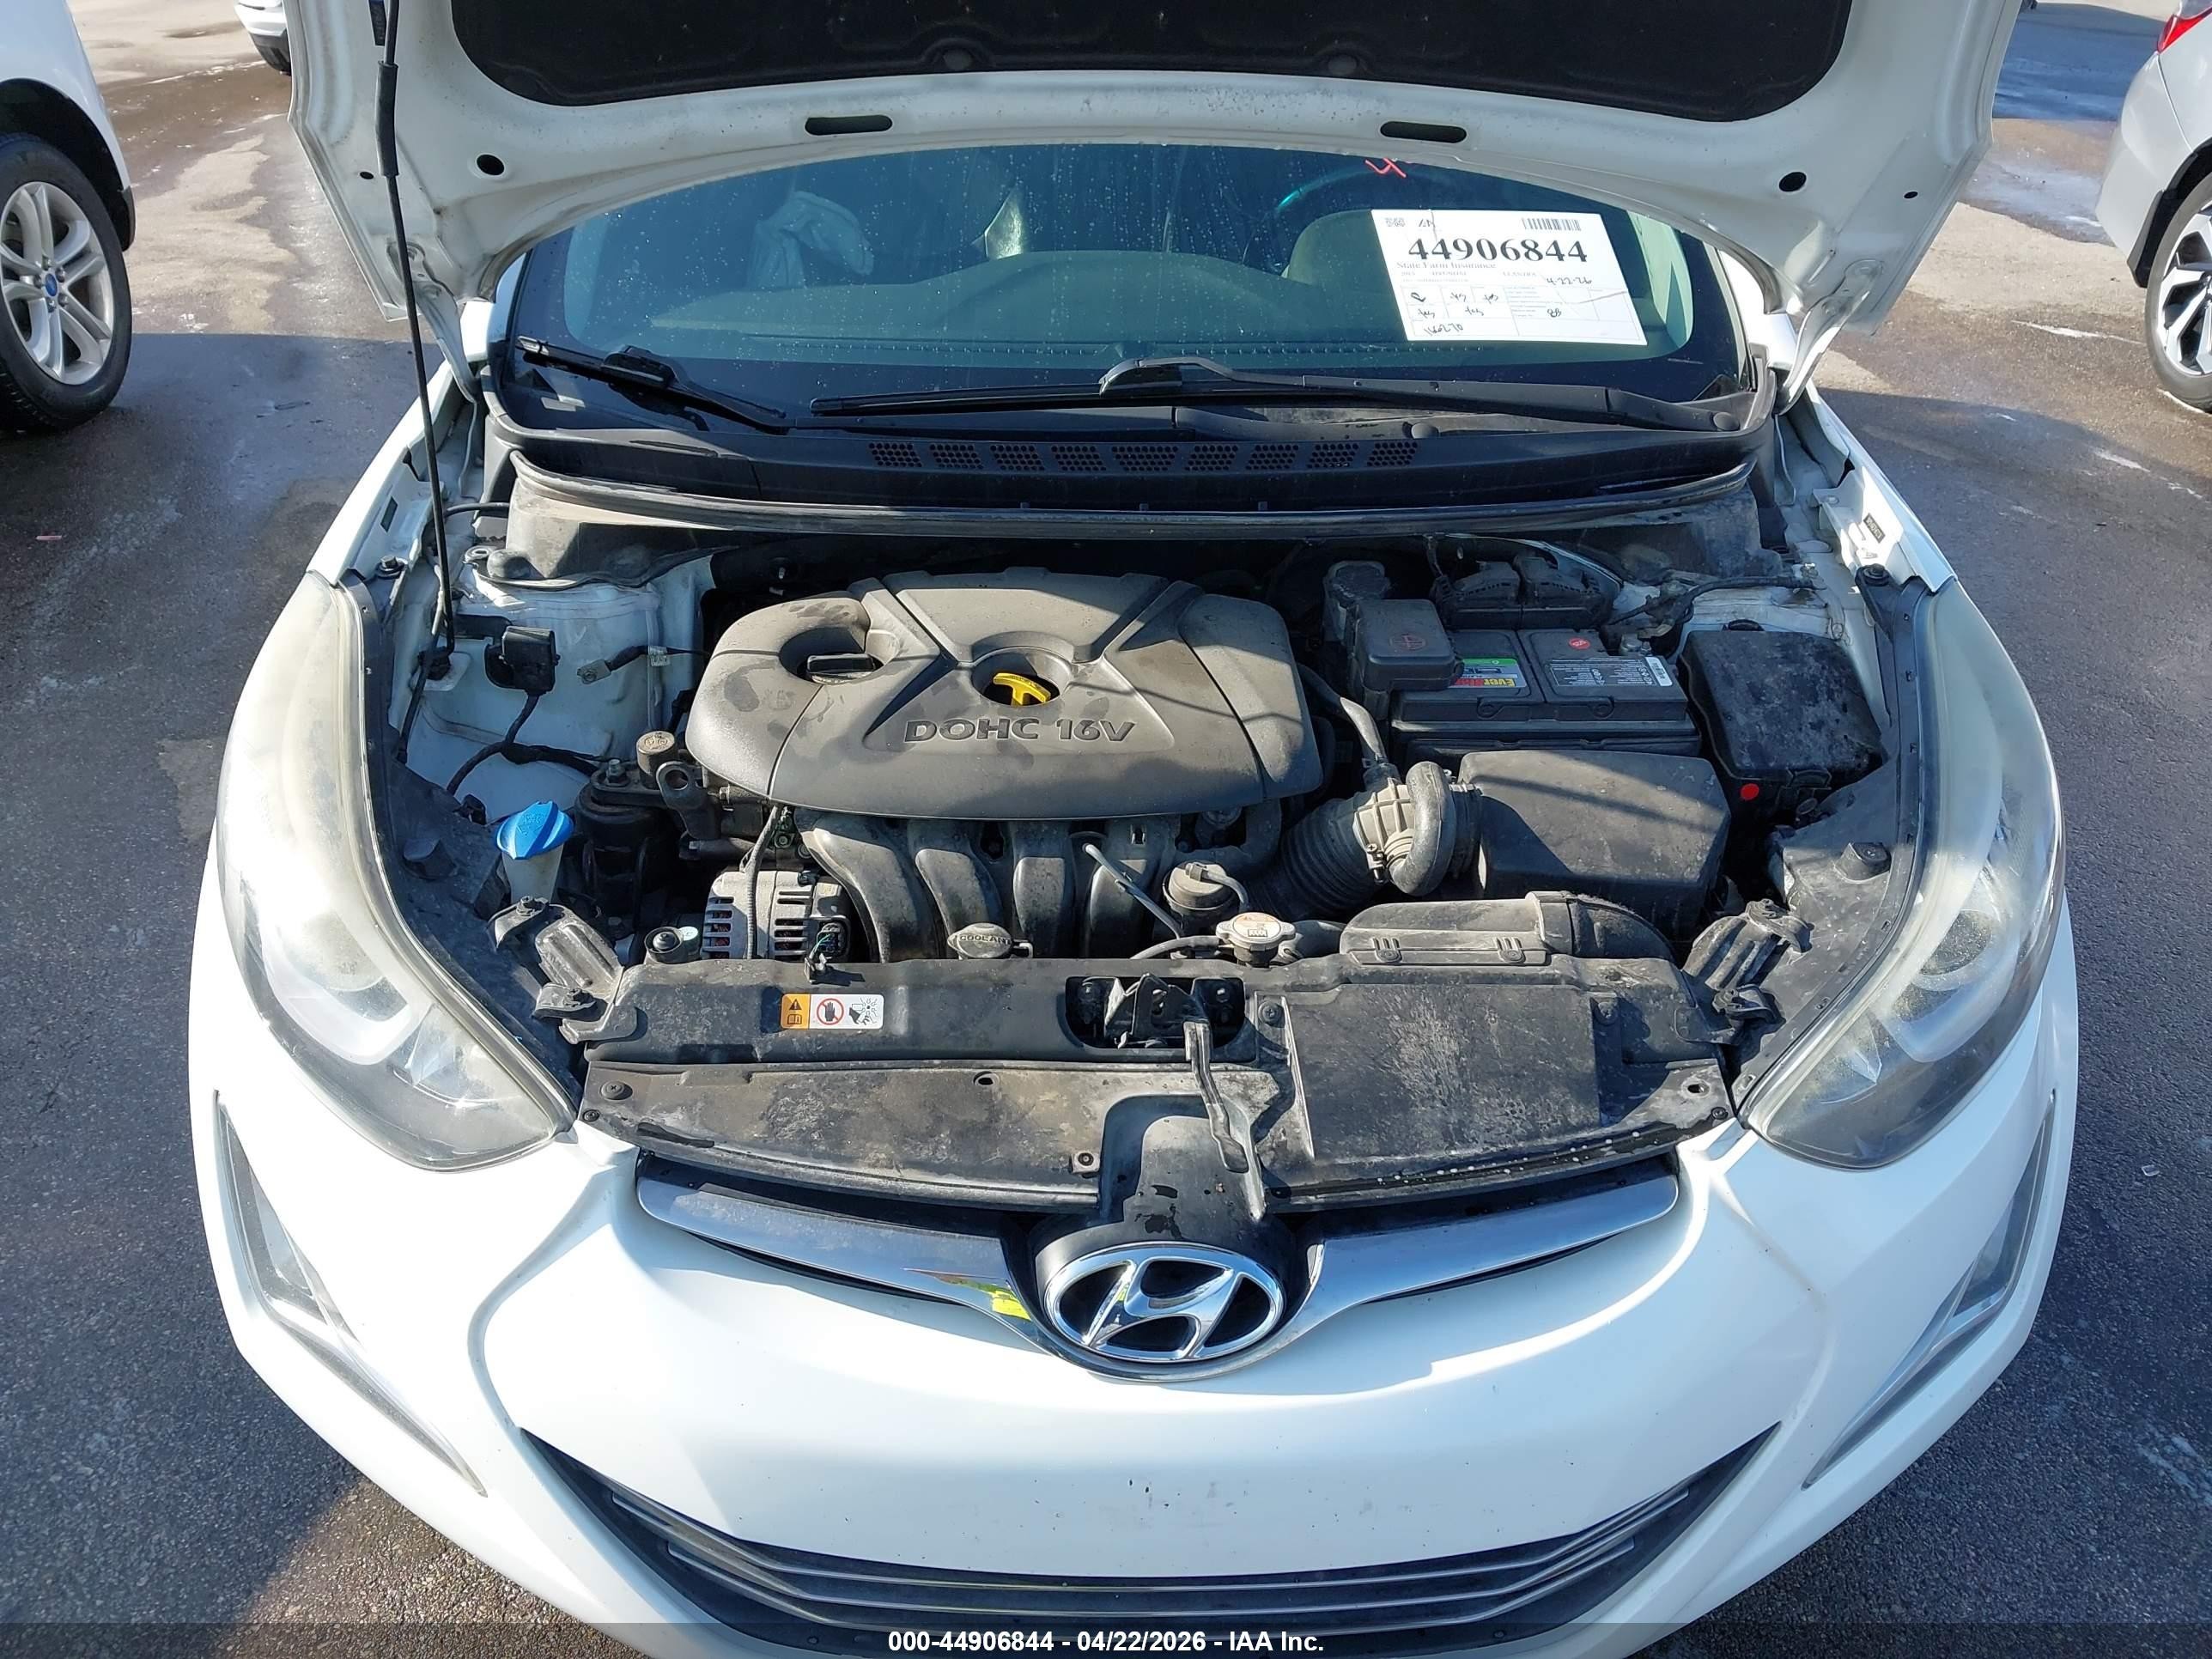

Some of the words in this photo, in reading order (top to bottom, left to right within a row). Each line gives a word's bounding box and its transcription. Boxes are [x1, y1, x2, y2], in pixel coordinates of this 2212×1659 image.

[1408, 238, 1587, 263] 44906844
[904, 718, 1040, 743] DOHC
[1055, 719, 1135, 742] 16V
[960, 934, 1011, 945] COOLANT
